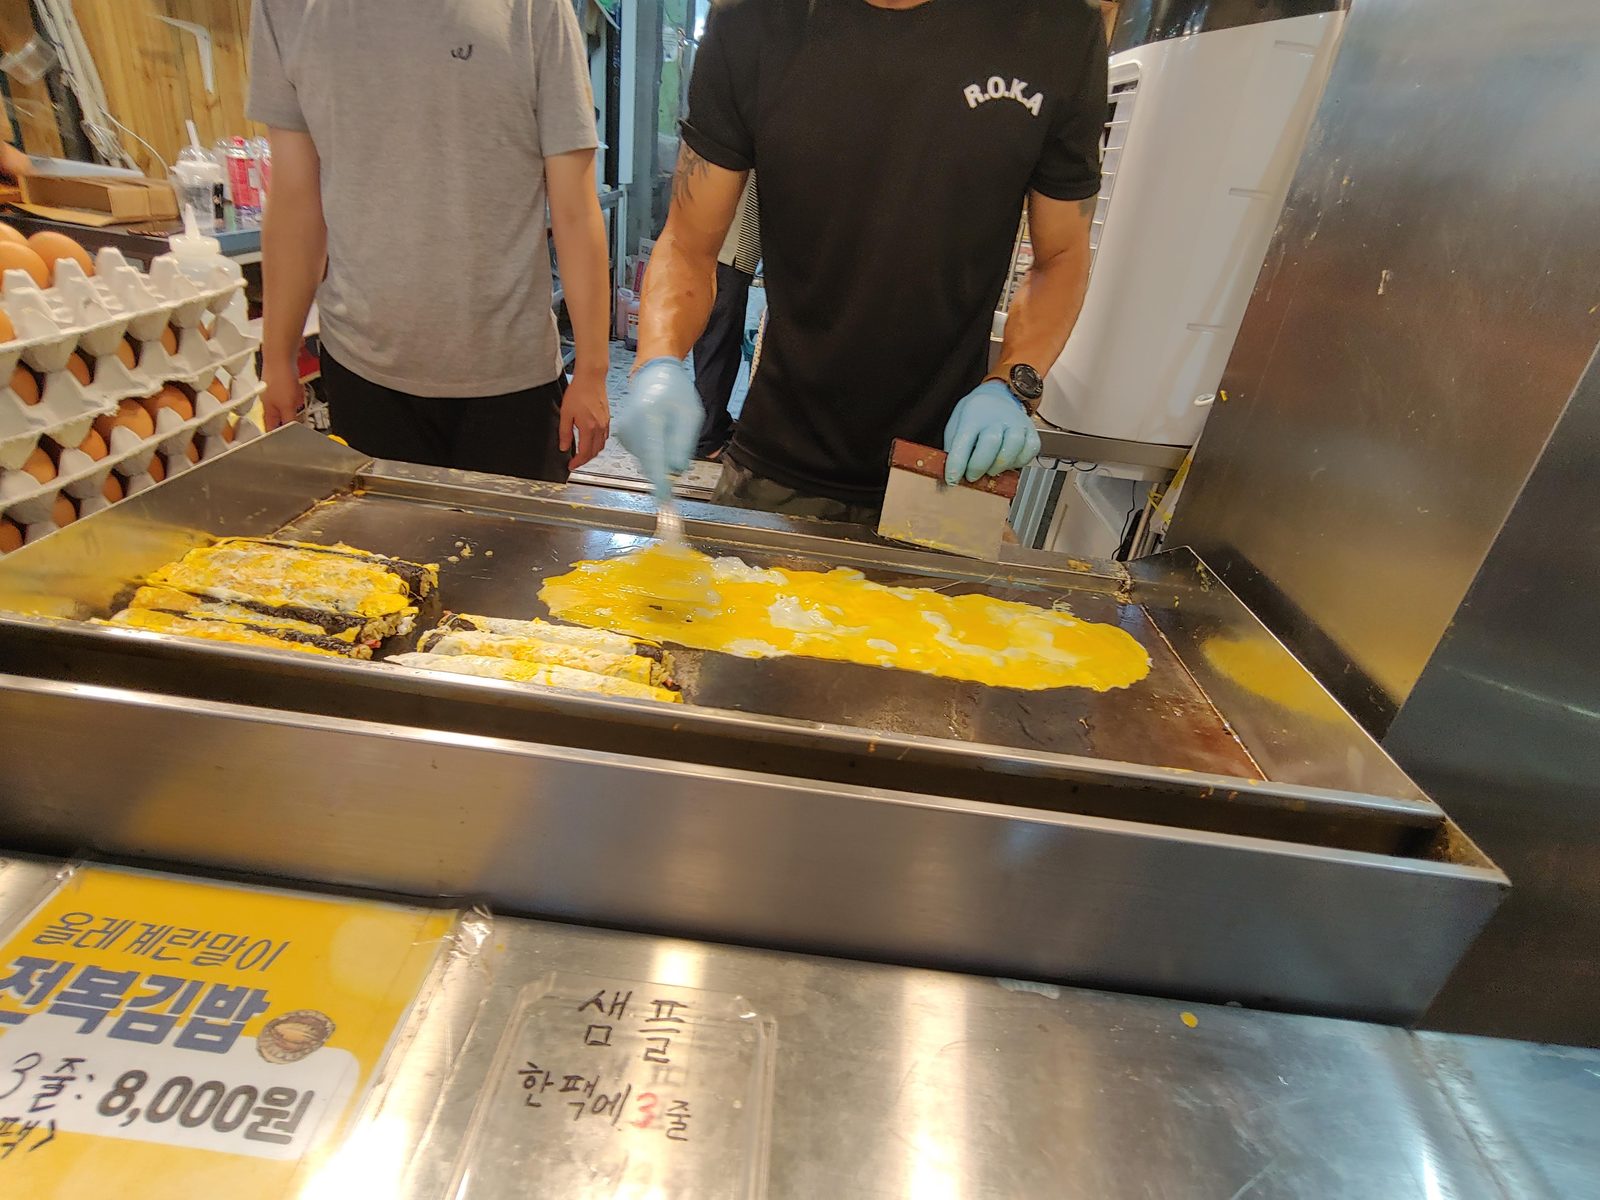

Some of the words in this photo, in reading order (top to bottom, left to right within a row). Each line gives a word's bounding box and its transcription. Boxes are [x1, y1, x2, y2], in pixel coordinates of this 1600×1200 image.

[32, 912, 136, 950] 올레
[123, 922, 291, 972] 계란말이
[0, 955, 271, 1054] 전복김밥
[577, 989, 689, 1064] 샘플
[97, 1069, 315, 1145] 8,000원
